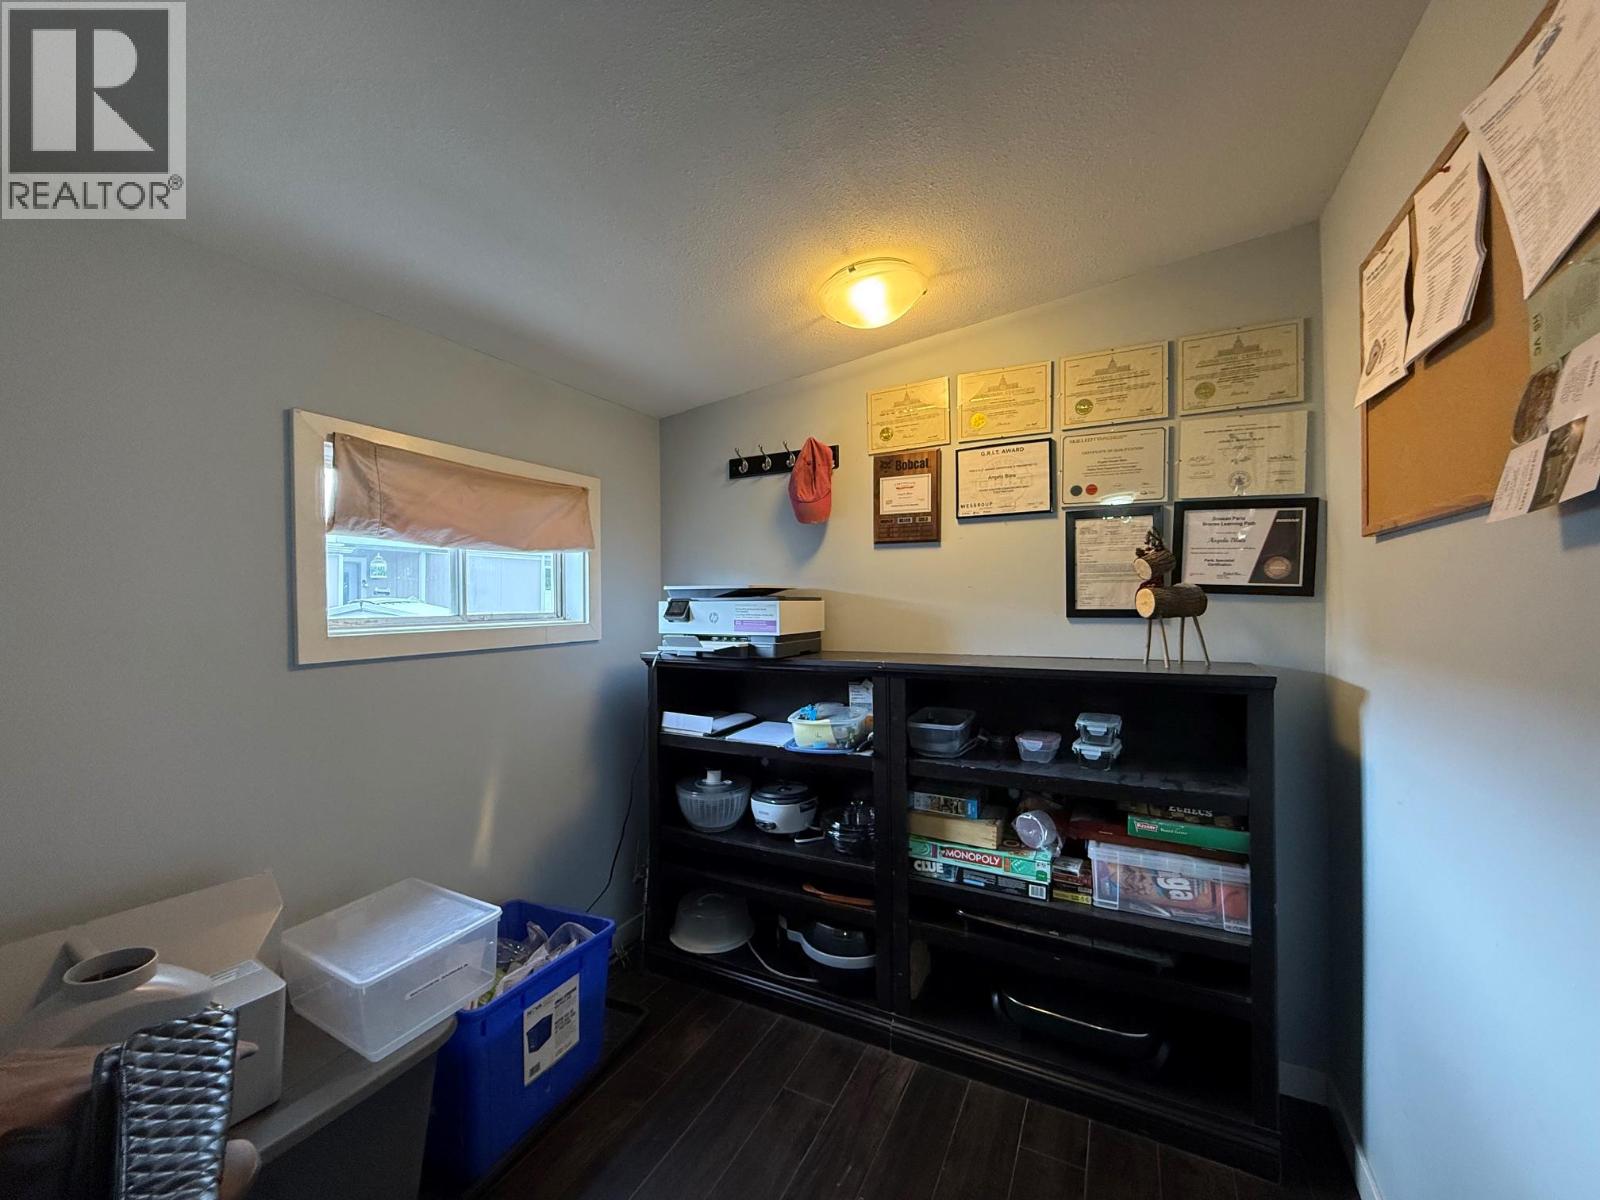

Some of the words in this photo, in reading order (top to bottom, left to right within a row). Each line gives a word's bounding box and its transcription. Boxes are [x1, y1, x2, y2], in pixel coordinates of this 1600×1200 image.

[1001, 446, 1025, 454] AWARD
[895, 458, 929, 471] Bobcat
[944, 848, 1000, 865] MONOPOLY
[913, 860, 945, 874] CLUE
